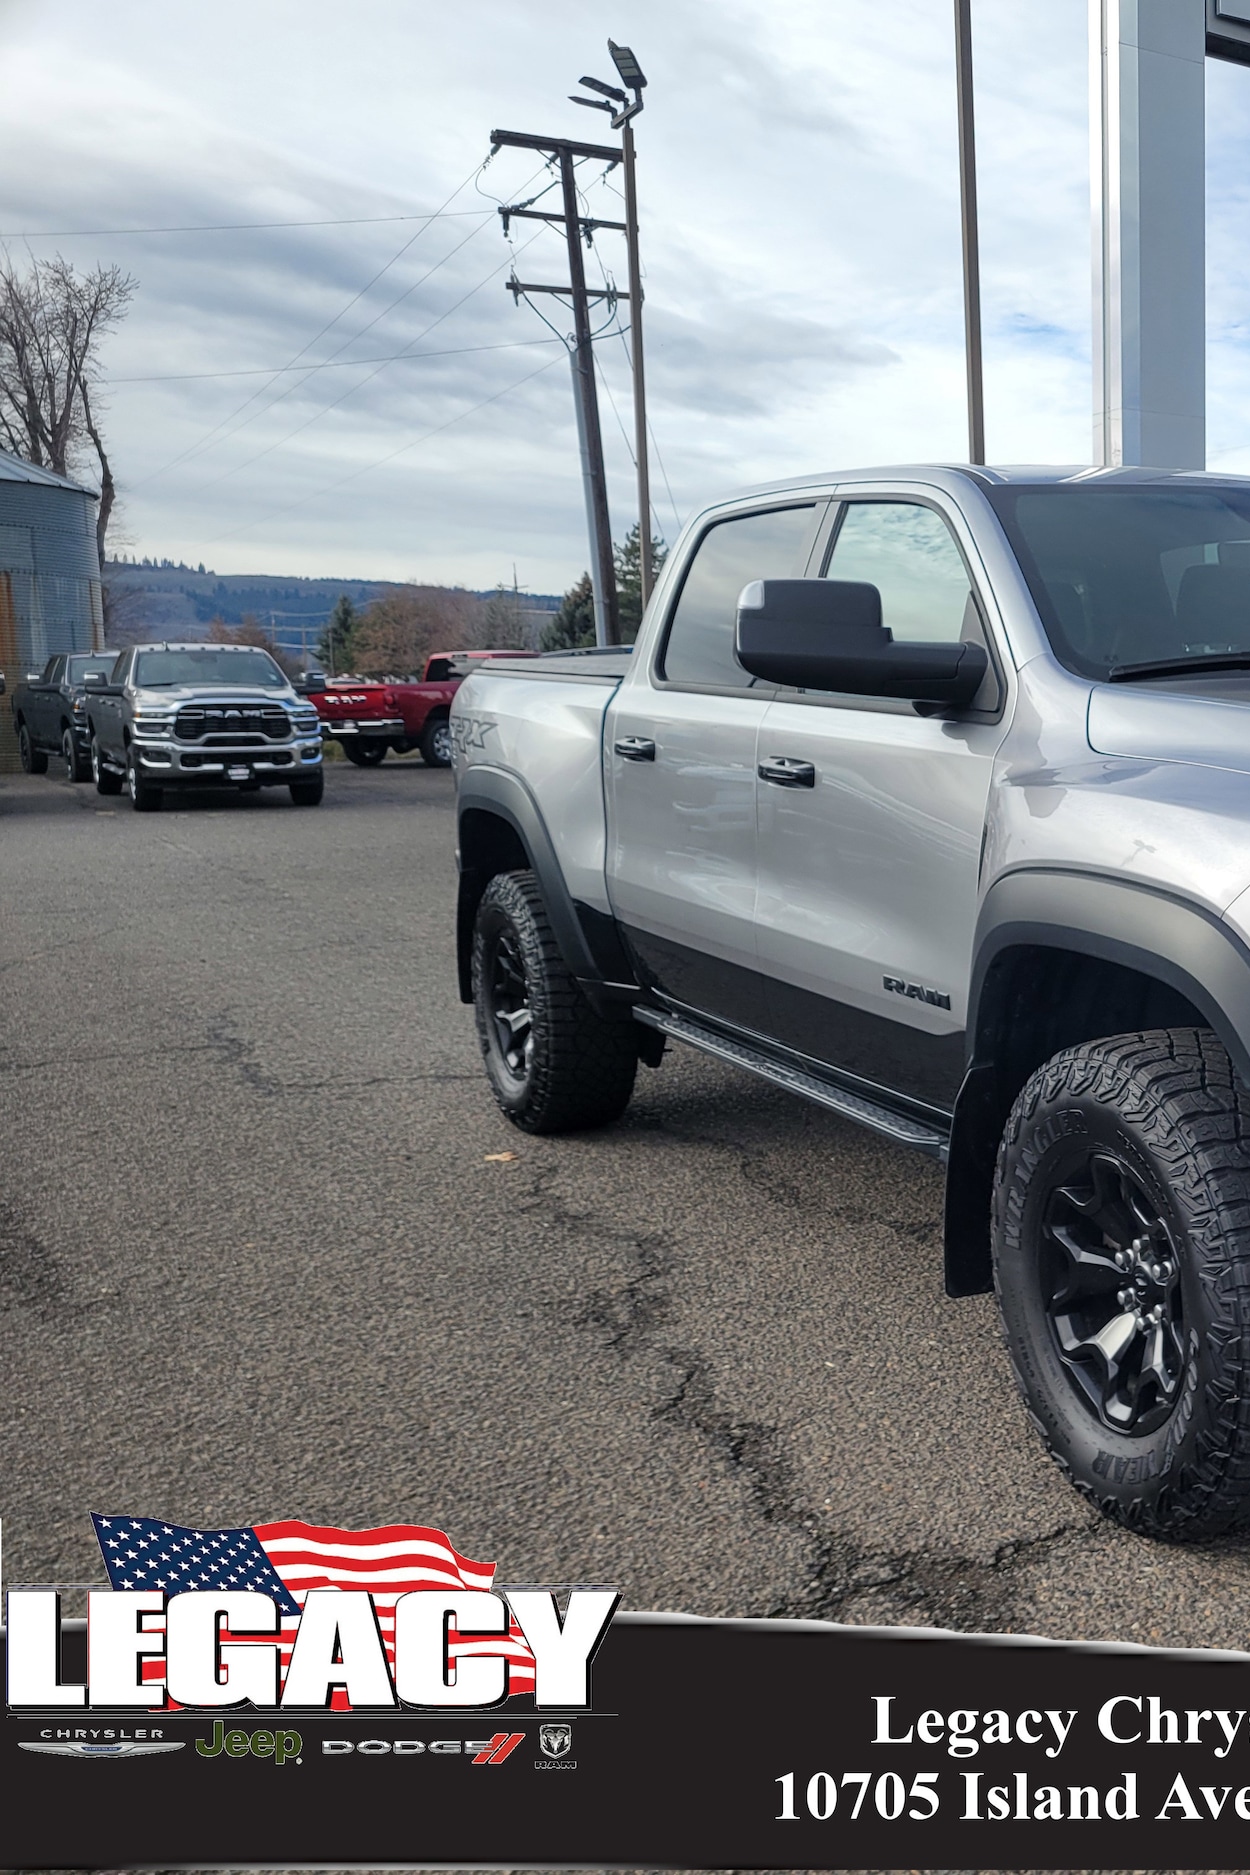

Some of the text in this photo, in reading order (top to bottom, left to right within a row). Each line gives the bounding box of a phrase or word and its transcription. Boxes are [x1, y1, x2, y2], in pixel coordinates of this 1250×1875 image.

[205, 709, 261, 718] RAM
[883, 974, 951, 1011] RAM
[1004, 1108, 1089, 1250] WRANGLER
